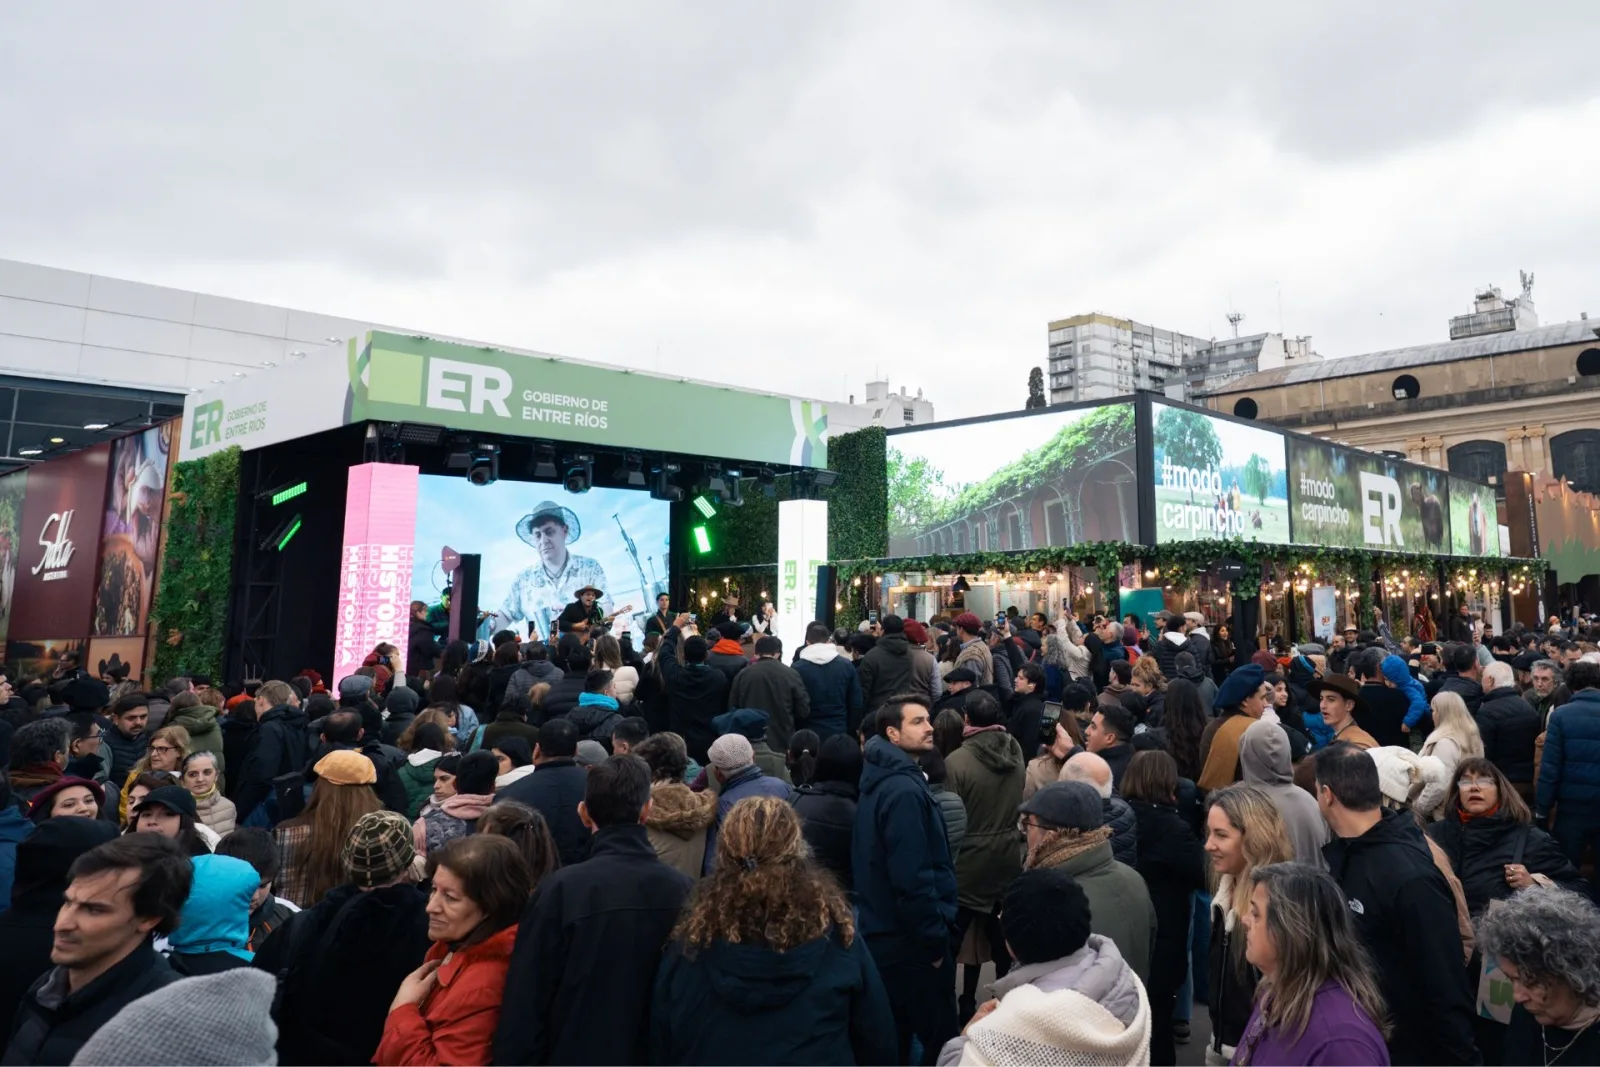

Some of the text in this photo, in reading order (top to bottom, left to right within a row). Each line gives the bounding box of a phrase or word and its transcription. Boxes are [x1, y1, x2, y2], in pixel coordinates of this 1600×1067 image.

[426, 356, 513, 418] ER
[523, 390, 608, 412] GOBIERNO DE
[190, 400, 224, 450] ER
[227, 400, 268, 422] GOBIERNO DE
[522, 406, 608, 429] ENTRE RÍOS
[225, 422, 248, 440] ENTRE
[1162, 455, 1222, 496] #modo
[1300, 472, 1335, 500] #modo
[1163, 499, 1245, 540] carpincho
[1302, 500, 1350, 529] carpincho
[1359, 470, 1405, 546] ER
[784, 559, 797, 590] ER
[341, 546, 359, 667] HISTORIA
[374, 545, 400, 650] HISTORI
